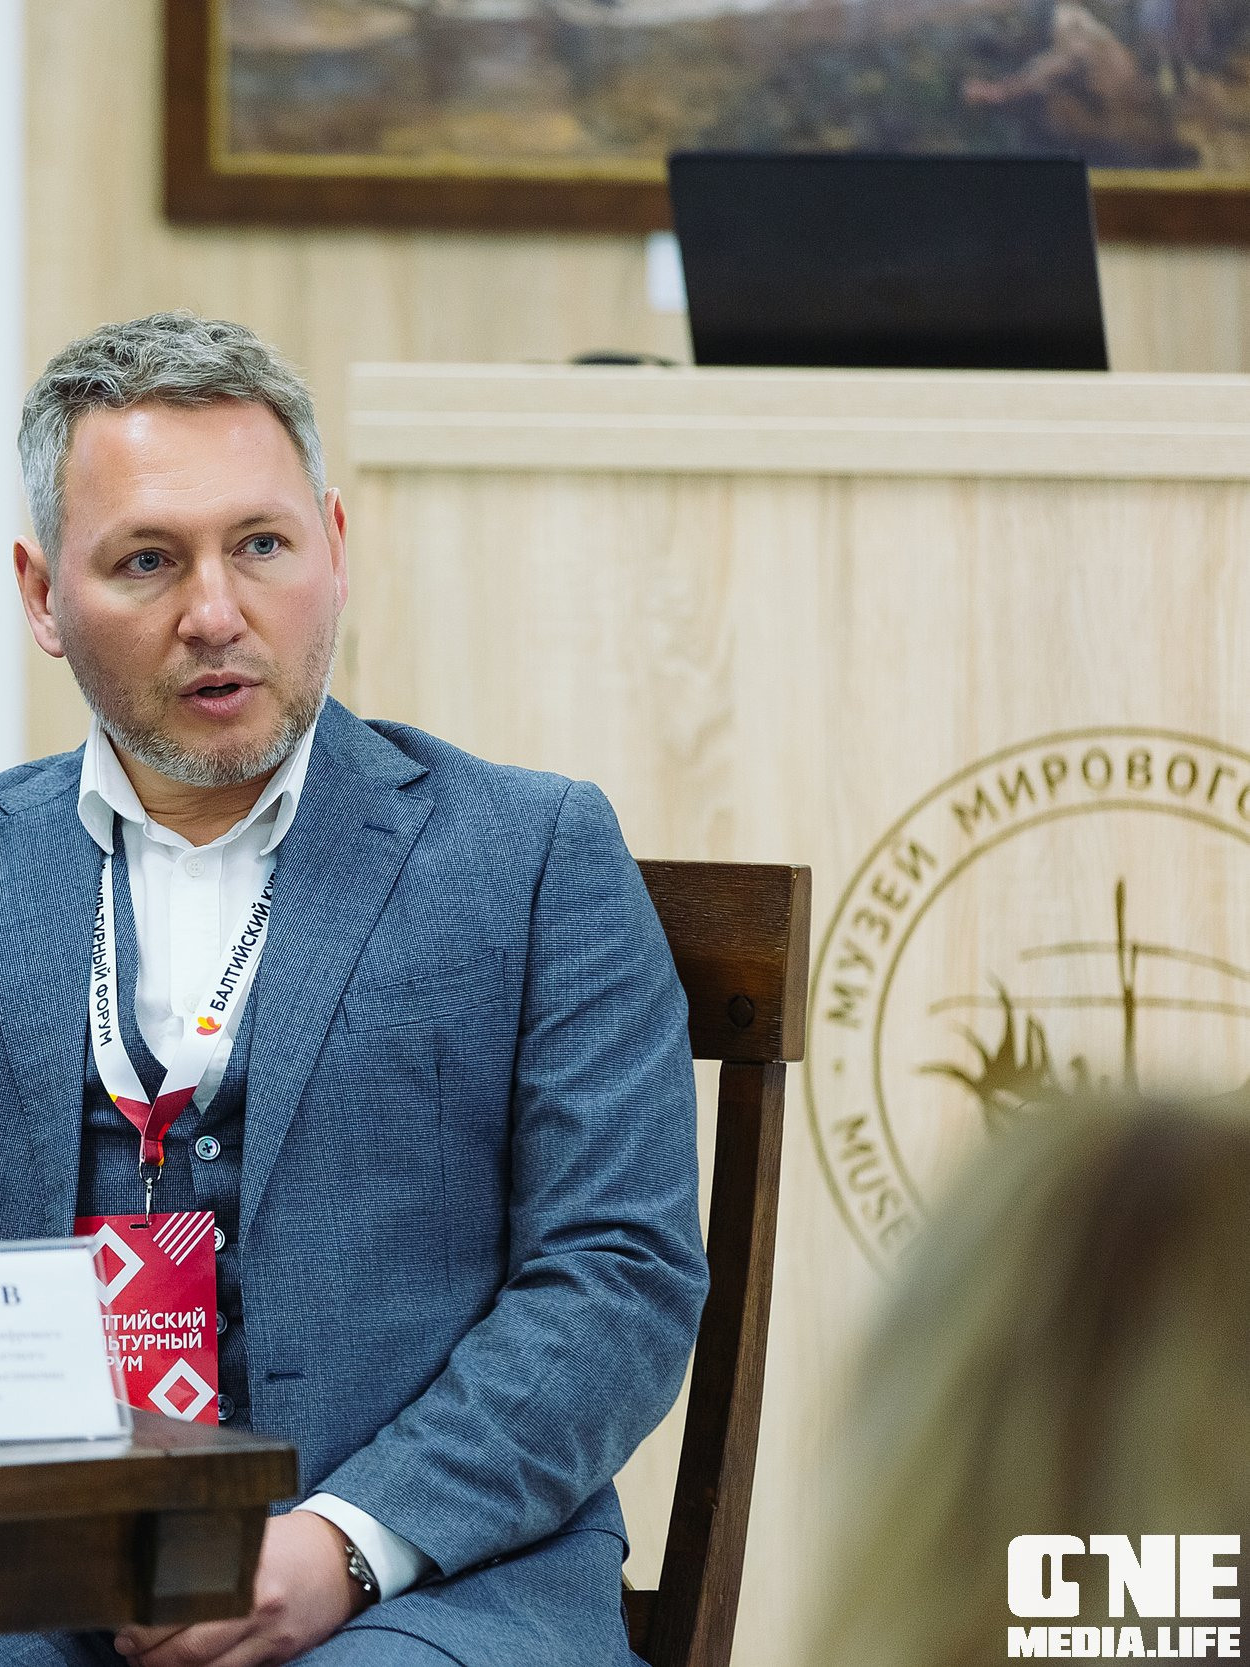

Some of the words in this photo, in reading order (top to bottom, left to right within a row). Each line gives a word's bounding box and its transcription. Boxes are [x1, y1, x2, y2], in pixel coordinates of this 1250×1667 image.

[210, 902, 270, 1011] БАЛТИЙСКИЙ
[826, 838, 938, 1030] МУЗЕЙ
[95, 983, 112, 1047] ФОРУМ
